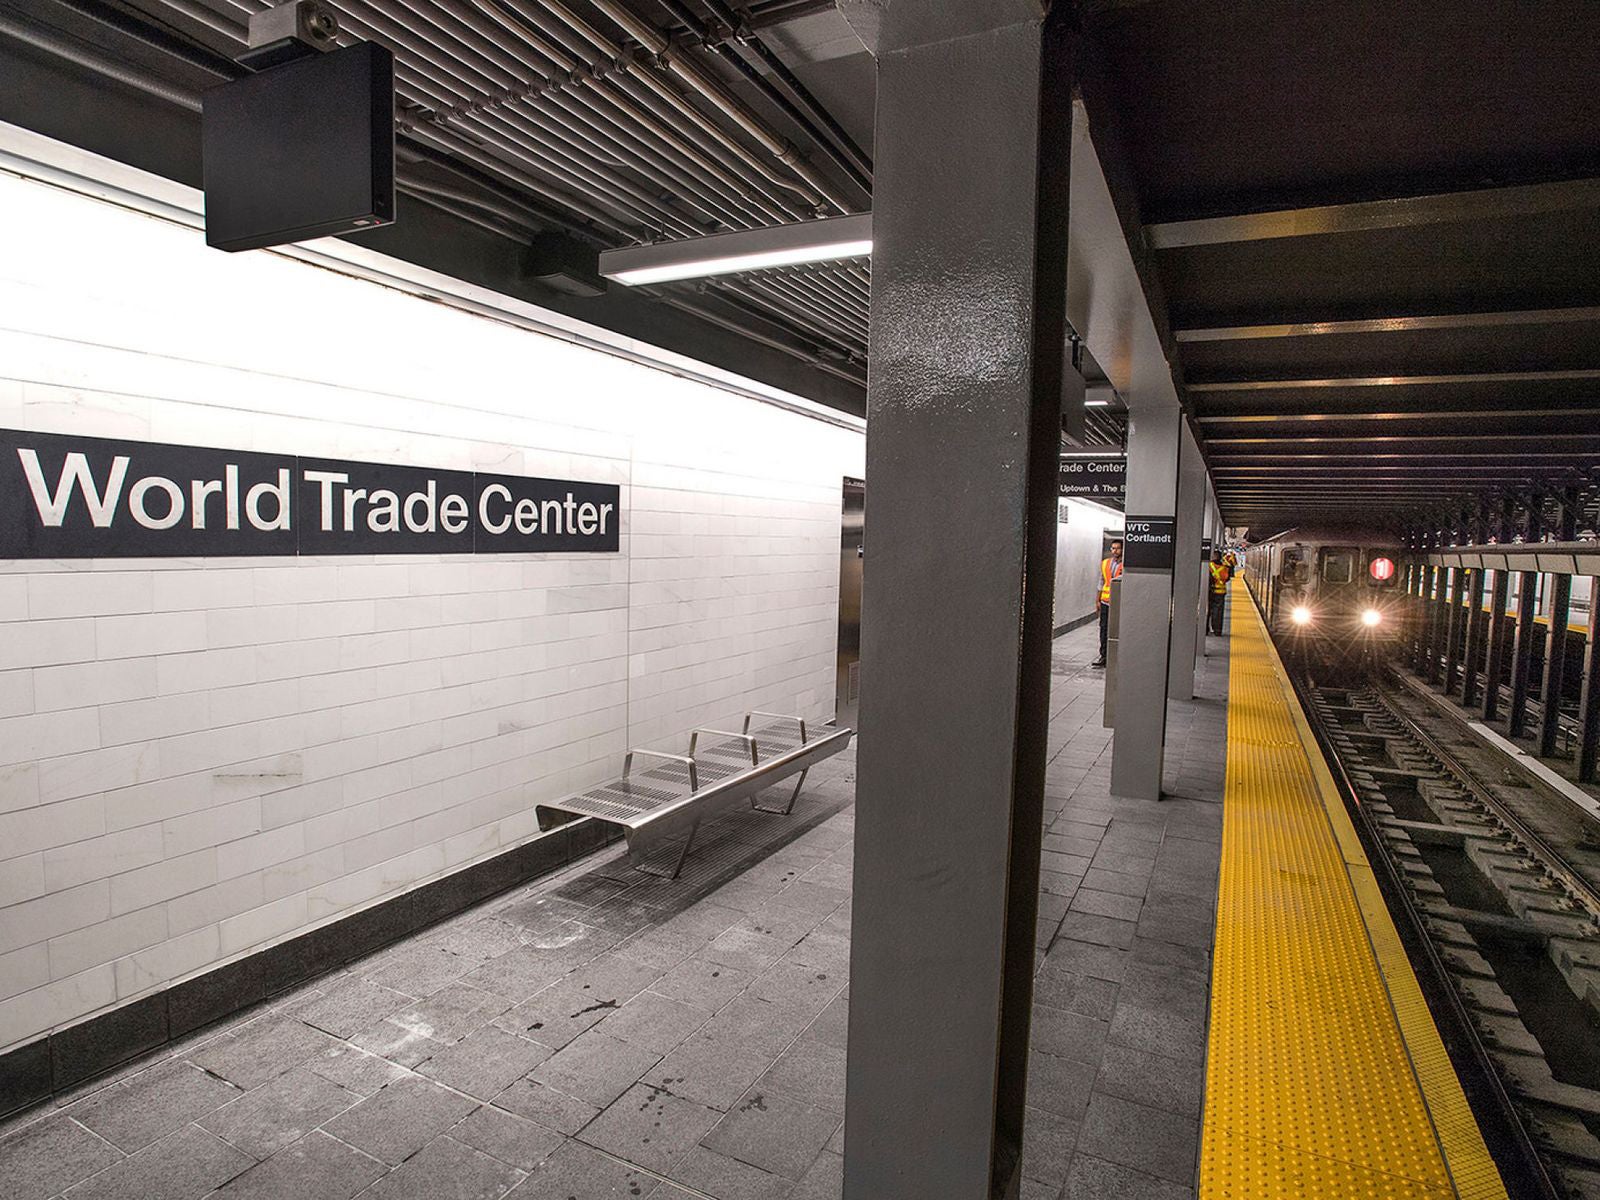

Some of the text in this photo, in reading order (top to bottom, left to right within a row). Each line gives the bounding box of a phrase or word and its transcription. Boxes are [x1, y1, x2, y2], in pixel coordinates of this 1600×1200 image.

[1059, 462, 1125, 473] rade Center
[16, 447, 614, 536] World Trade Center
[1060, 484, 1091, 493] Uptown
[1092, 484, 1099, 493] &
[1102, 484, 1118, 493] The
[1126, 523, 1150, 532] WTC
[1126, 533, 1171, 543] Cortlandt
